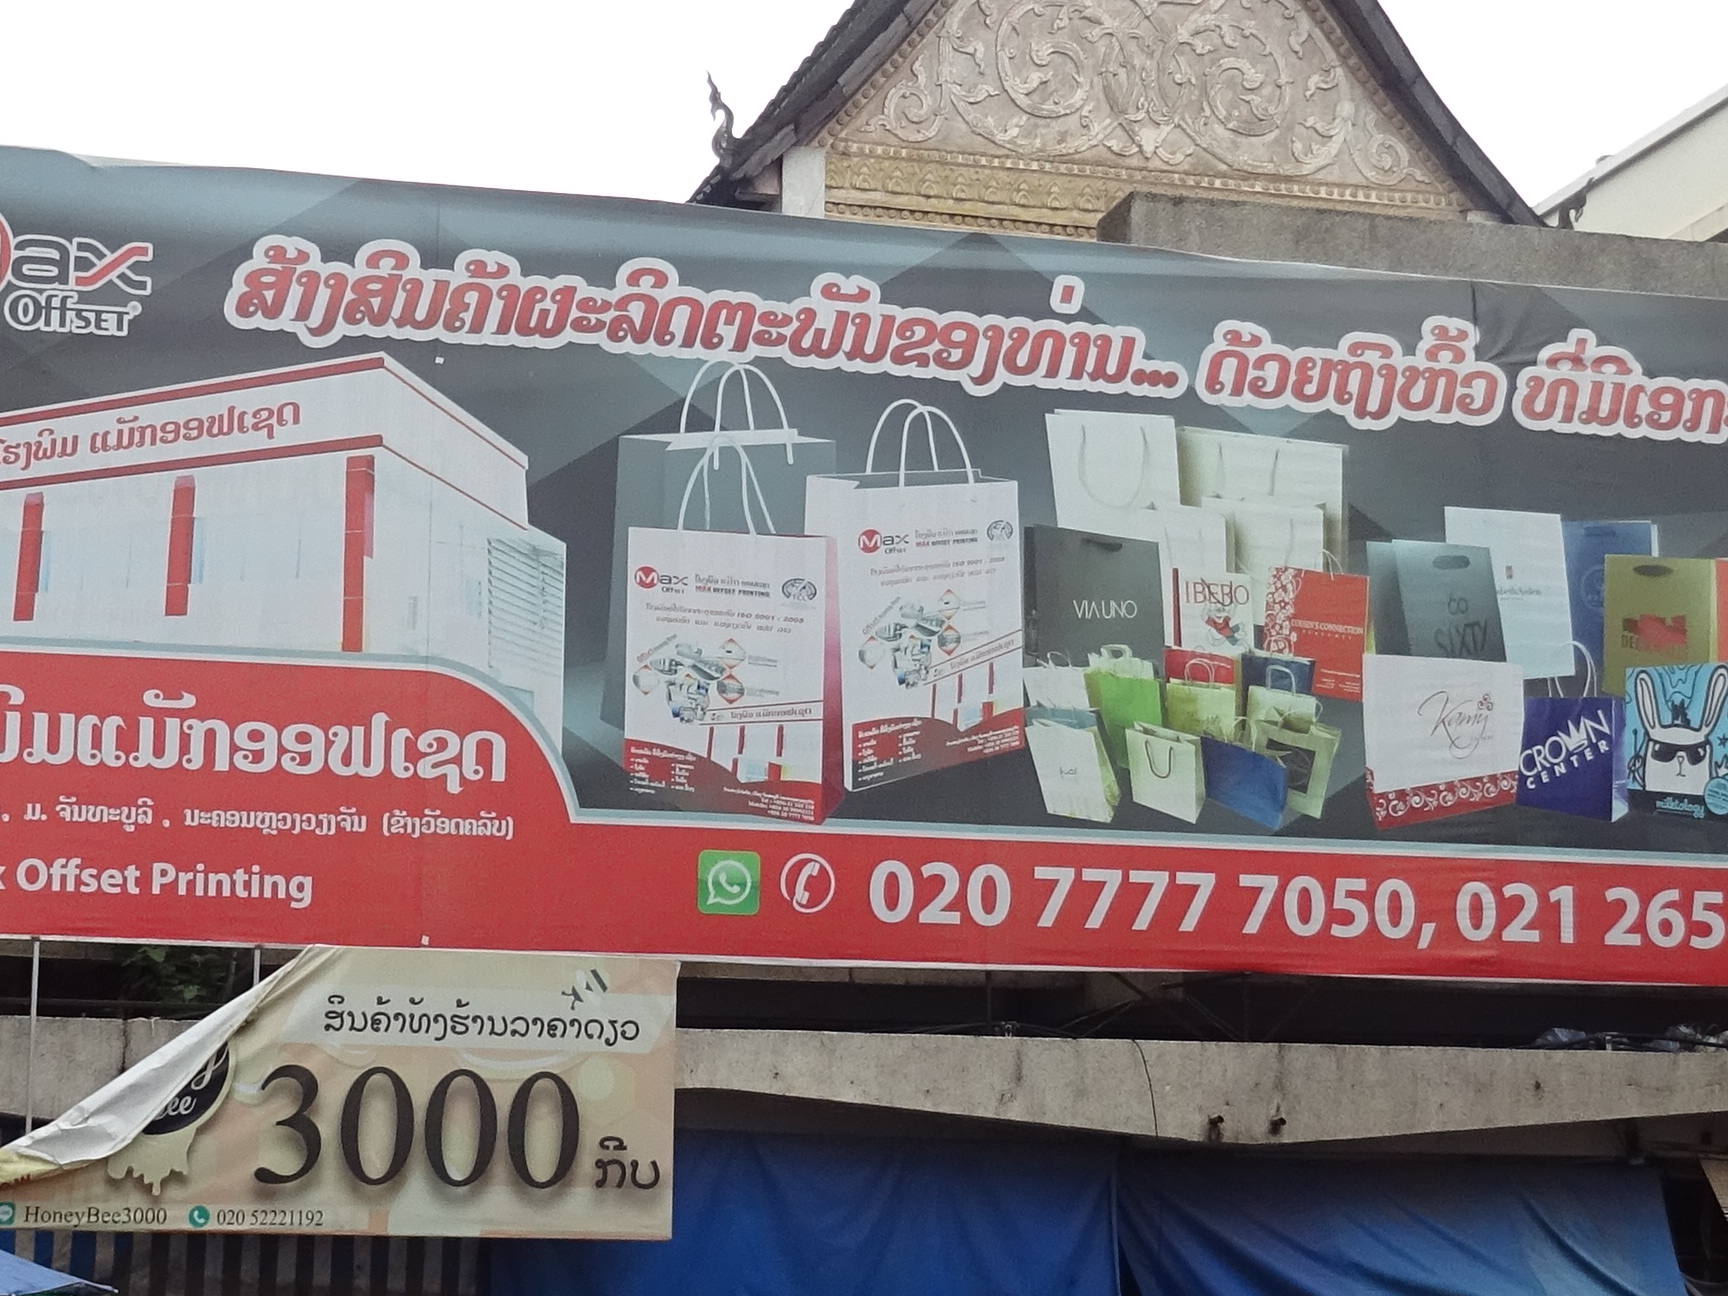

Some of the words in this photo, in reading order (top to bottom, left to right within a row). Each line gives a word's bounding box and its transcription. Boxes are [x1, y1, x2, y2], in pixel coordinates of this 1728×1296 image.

[858, 532, 910, 550] Max
[634, 570, 689, 588] Max
[1519, 709, 1611, 776] CROWN
[1526, 739, 1610, 789] CENTER
[23, 802, 48, 822] ມ.
[16, 856, 146, 897] Offset
[152, 864, 314, 909] Printing
[868, 859, 1012, 929] 020
[1032, 865, 1218, 934] 7777
[1238, 872, 1437, 951] 7050,
[1454, 879, 1579, 946] 021
[1603, 886, 1728, 951] 265
[252, 1062, 580, 1191] 3000
[594, 1135, 661, 1190] ກີບ
[22, 1205, 168, 1228] HoneyBee3000
[216, 1210, 246, 1227] 020
[249, 1209, 324, 1227] 52221192
